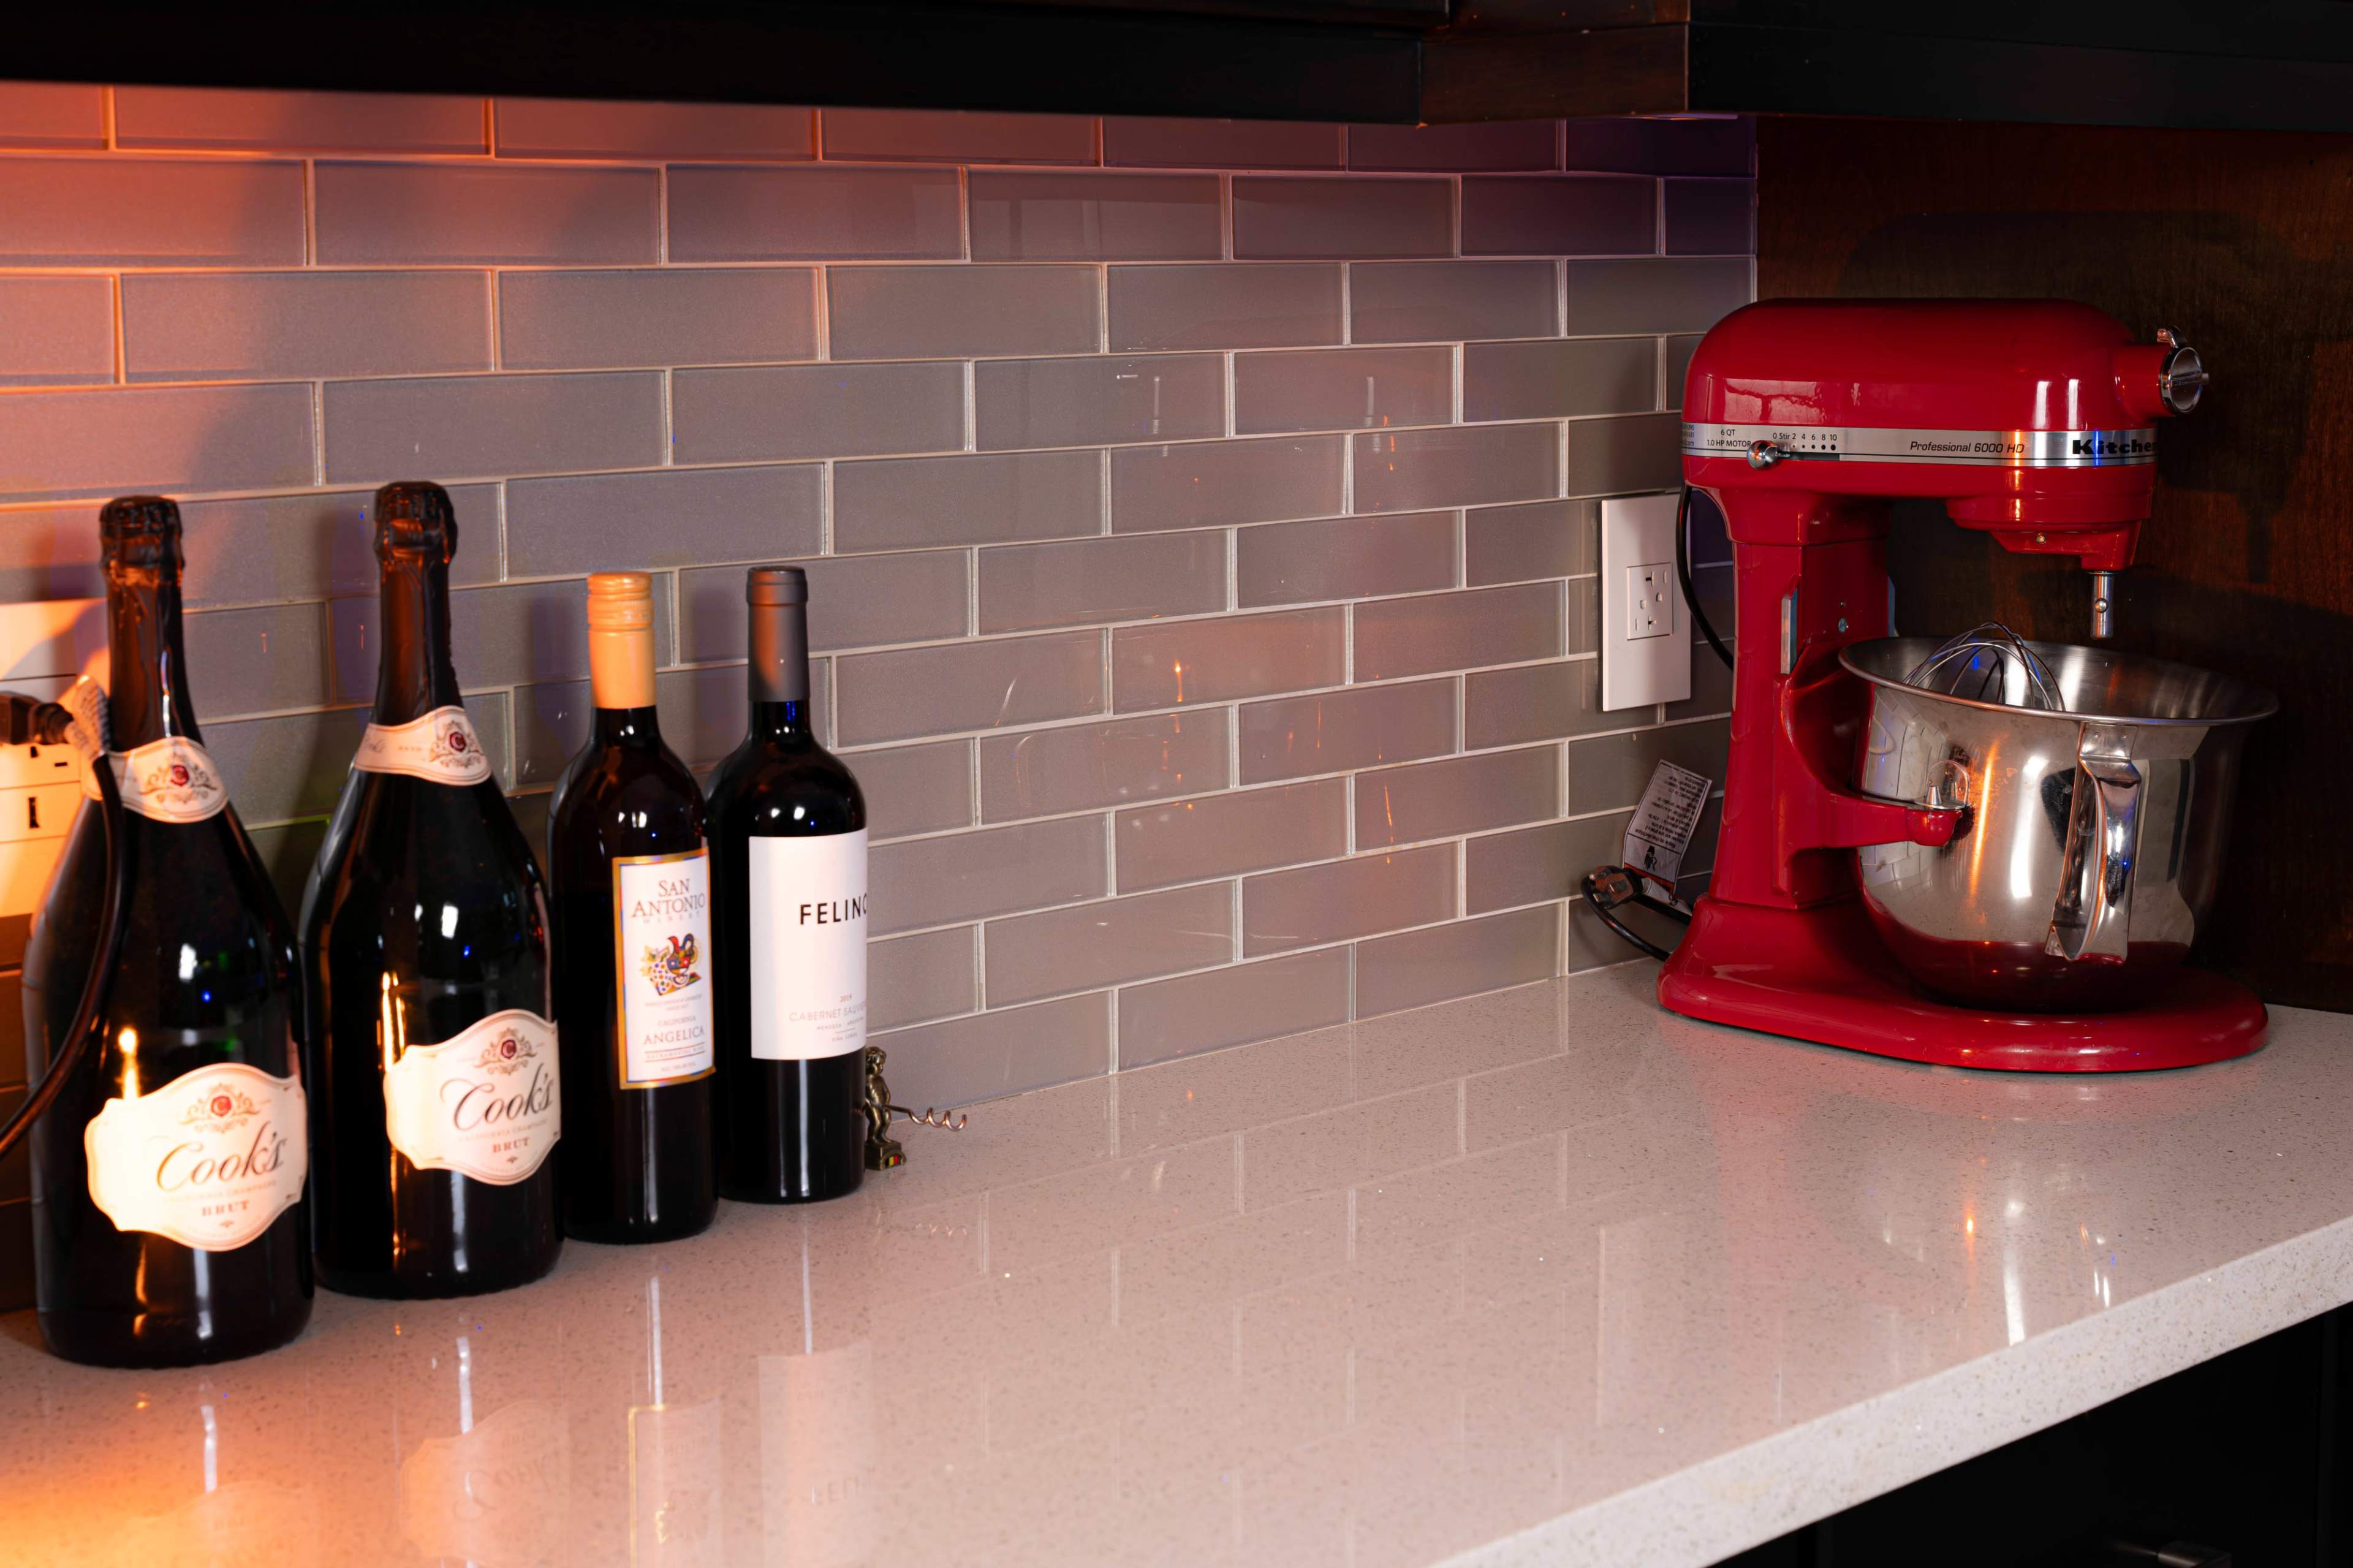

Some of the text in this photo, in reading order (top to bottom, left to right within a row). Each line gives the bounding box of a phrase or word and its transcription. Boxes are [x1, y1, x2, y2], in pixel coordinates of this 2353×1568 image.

[1726, 439, 1751, 448] MOTOR
[1910, 441, 2025, 453] Professional 6000 HD
[657, 878, 691, 898] SAN
[631, 893, 706, 918] ANTONIO
[789, 1008, 841, 1022] CABERNET
[643, 1025, 705, 1045] ANGELICA
[440, 1063, 555, 1131] Cook's
[492, 1137, 530, 1153] BRUT
[150, 1121, 288, 1192] Cook's
[202, 1200, 250, 1216] BRUT
